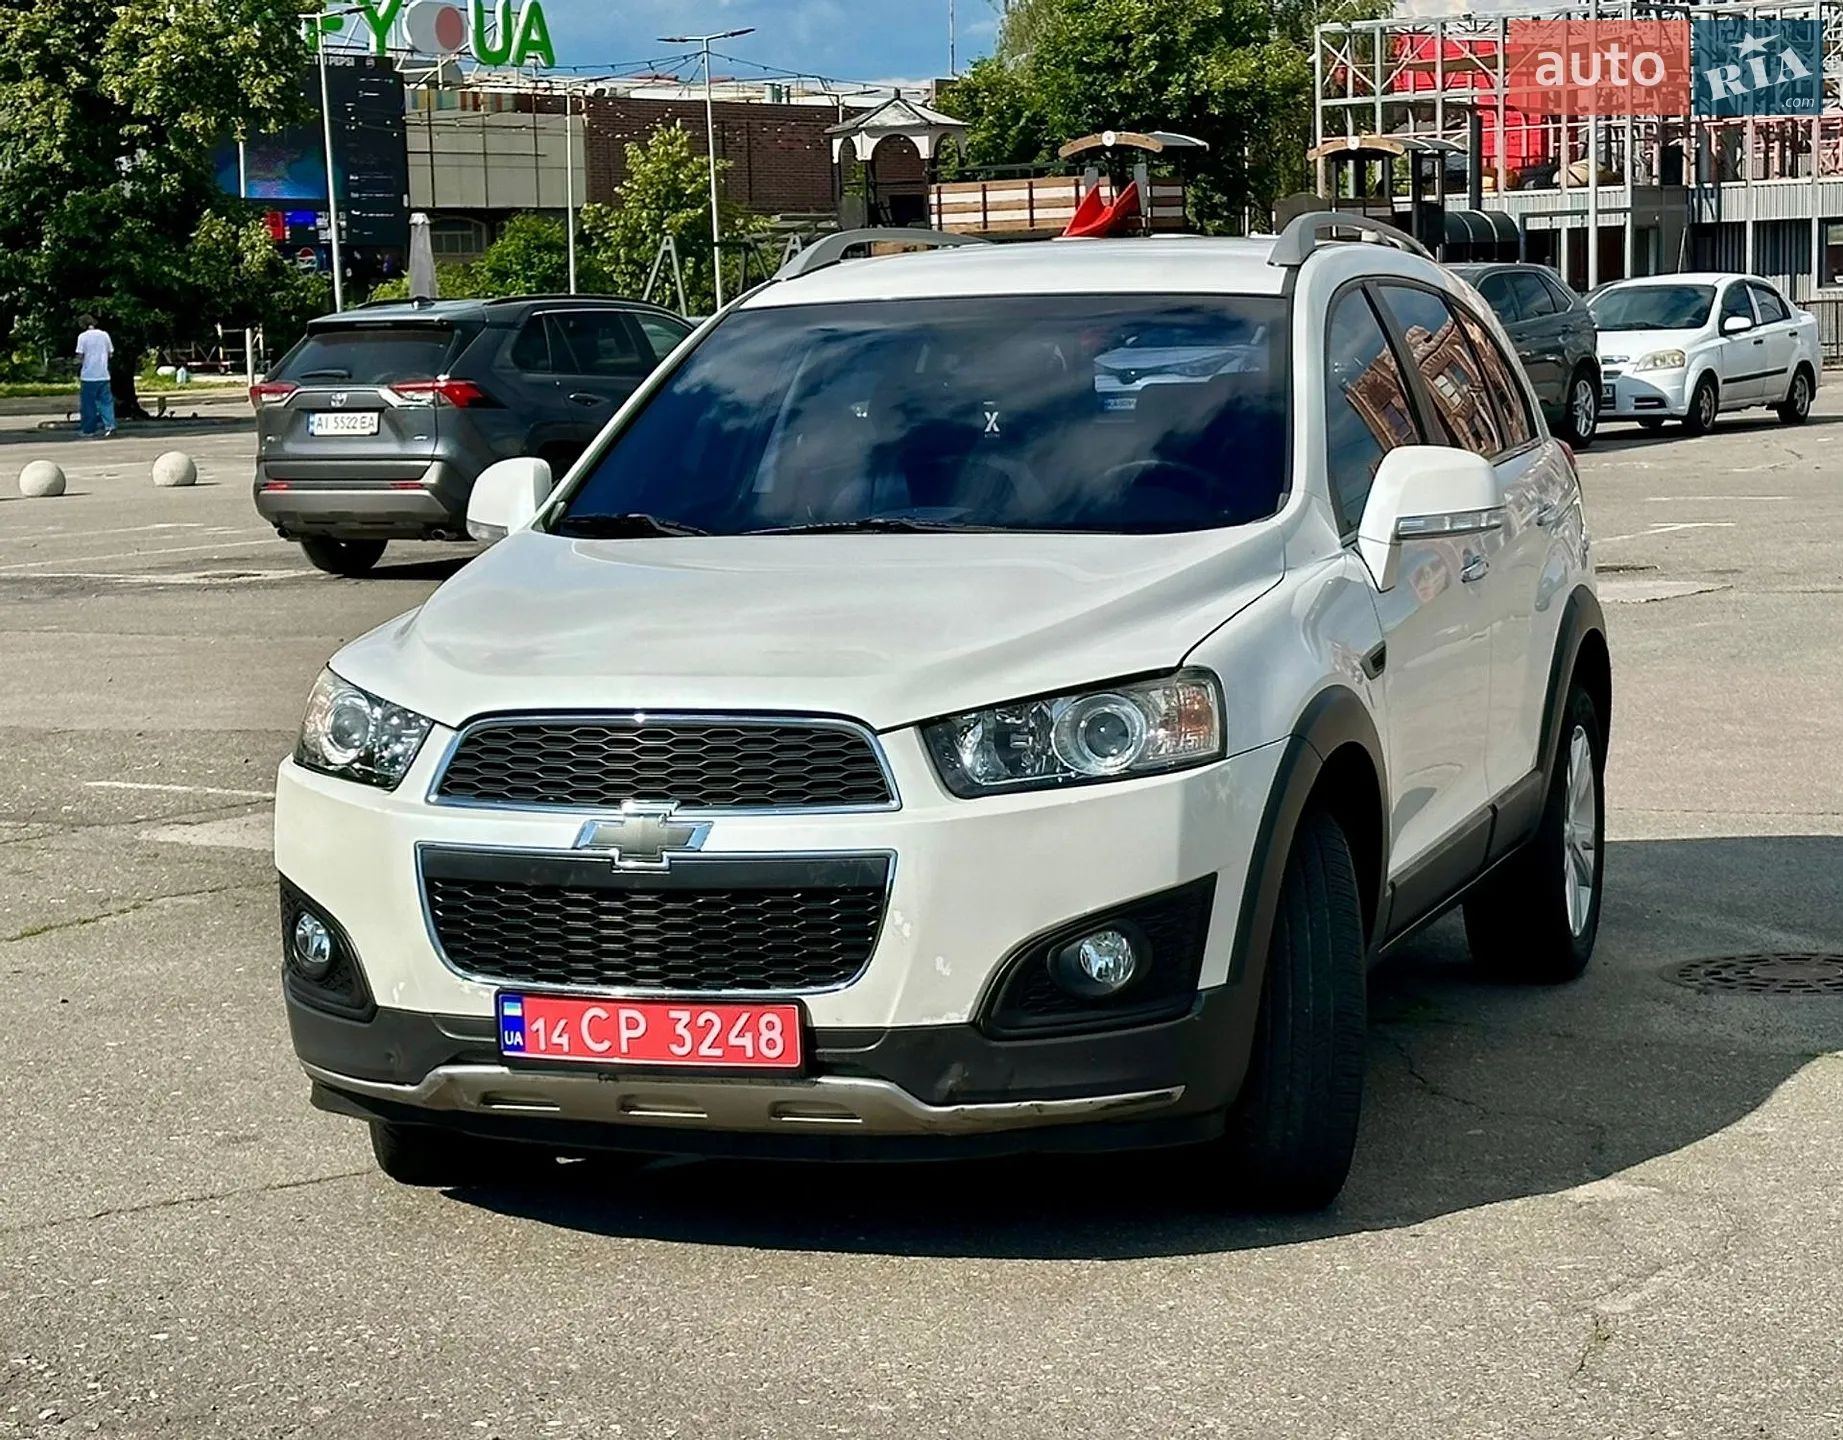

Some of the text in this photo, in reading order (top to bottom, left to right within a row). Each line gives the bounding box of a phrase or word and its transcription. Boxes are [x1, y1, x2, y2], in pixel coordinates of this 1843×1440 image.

[360, 415, 375, 429] EA
[504, 1030, 524, 1046] UA
[529, 1006, 785, 1060] 14 CP 3248
